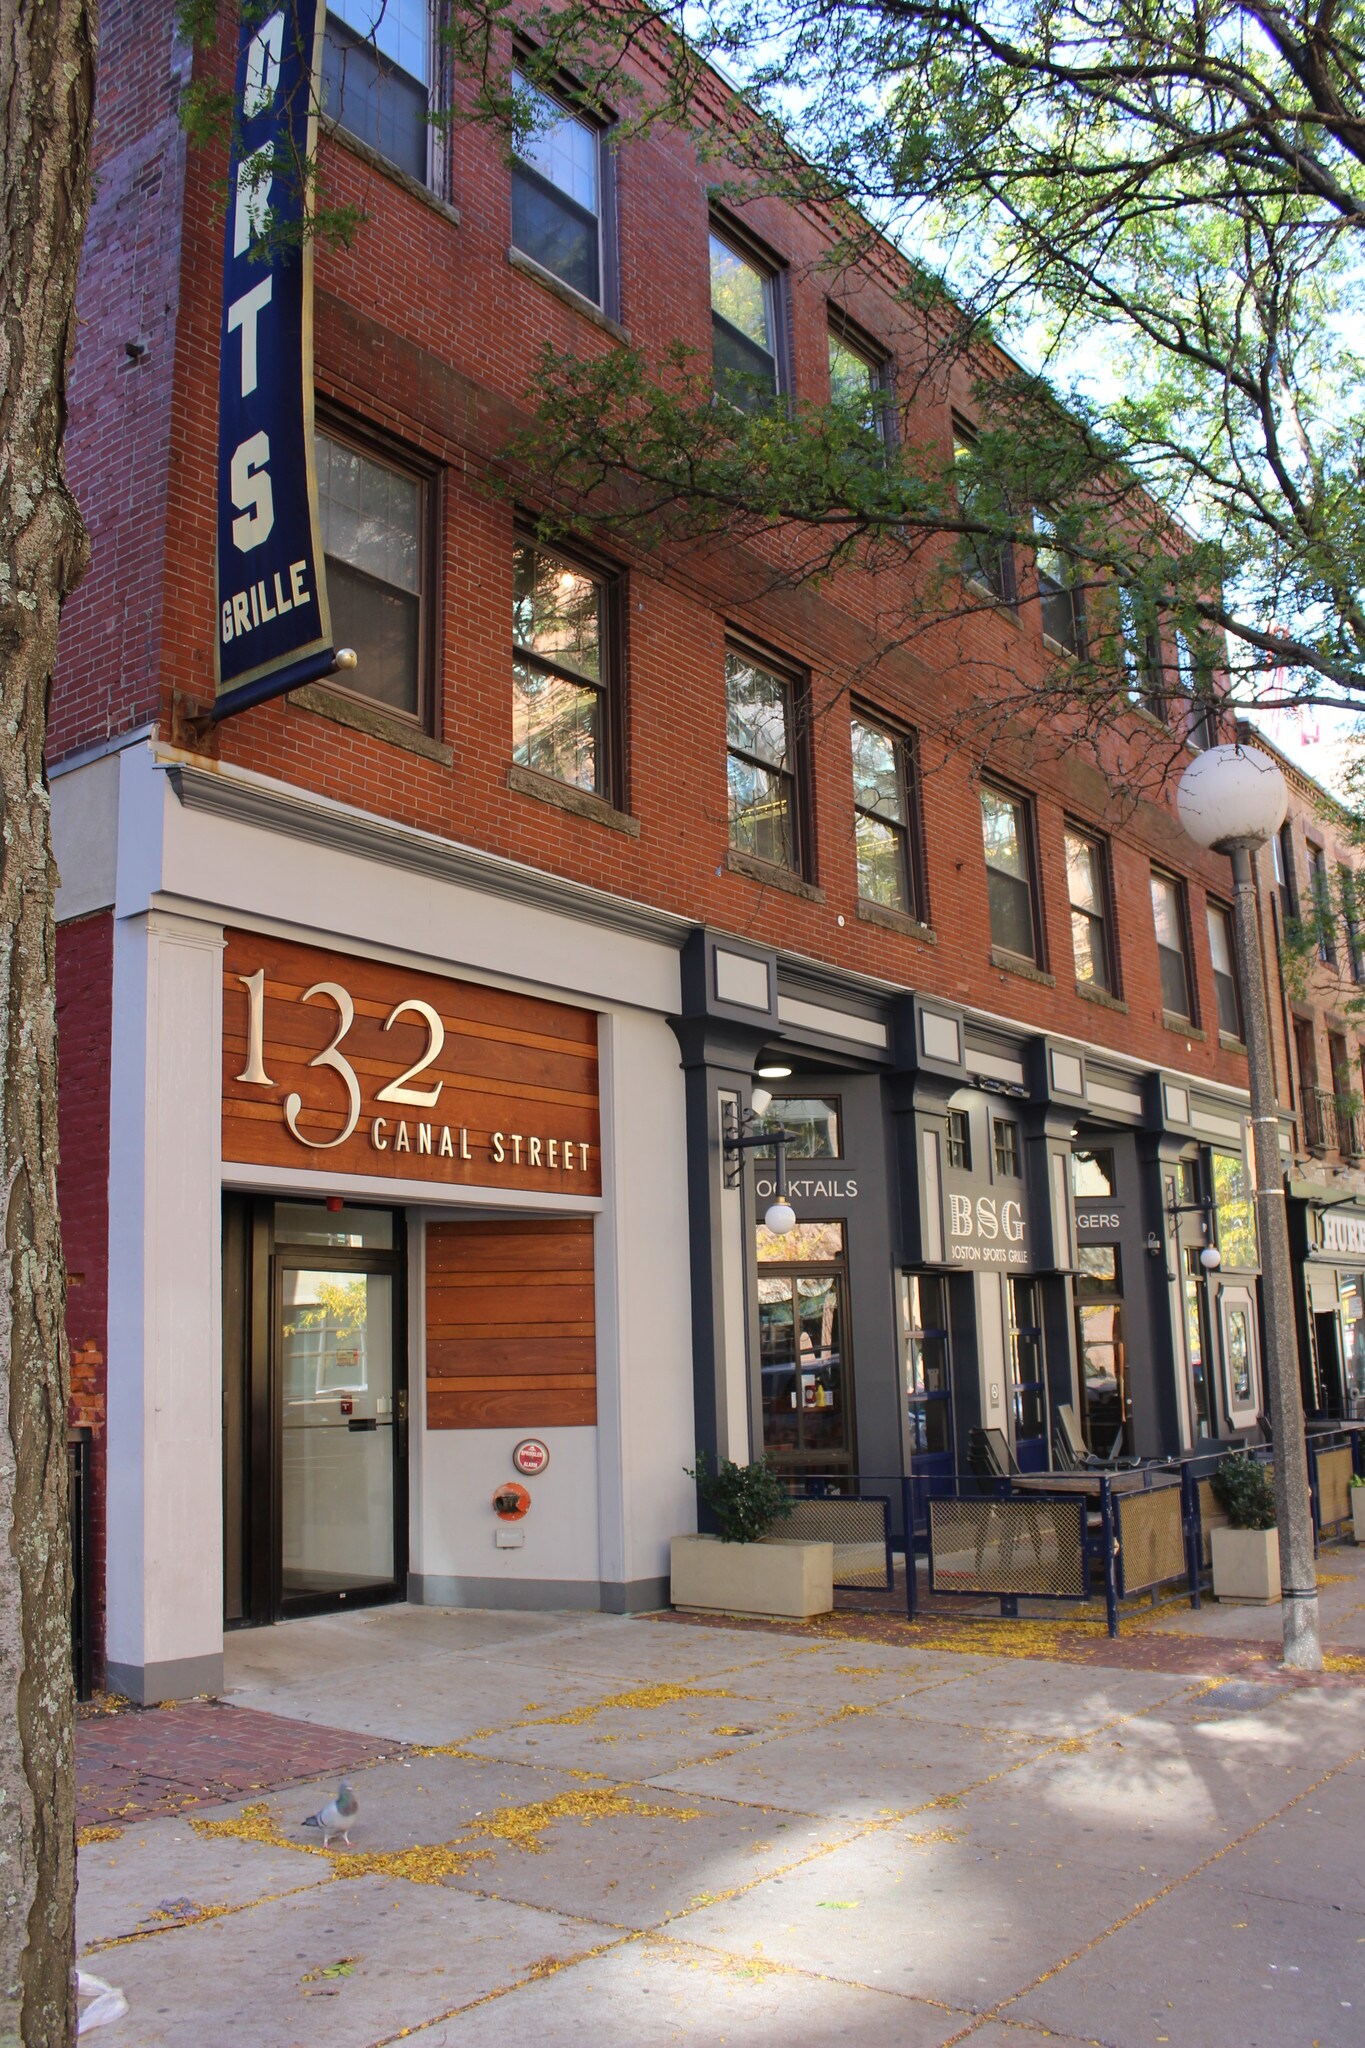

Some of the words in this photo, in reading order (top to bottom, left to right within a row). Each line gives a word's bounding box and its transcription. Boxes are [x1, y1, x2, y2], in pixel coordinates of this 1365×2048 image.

[222, 560, 310, 644] GRILLE
[234, 968, 445, 1149] 132
[371, 1117, 472, 1160] CANAL
[491, 1132, 590, 1172] STREET
[949, 1194, 1026, 1241] BSG
[1075, 1214, 1120, 1228] GERS
[983, 1247, 1007, 1262] SPORTS
[1008, 1249, 1028, 1264] GRILLE
